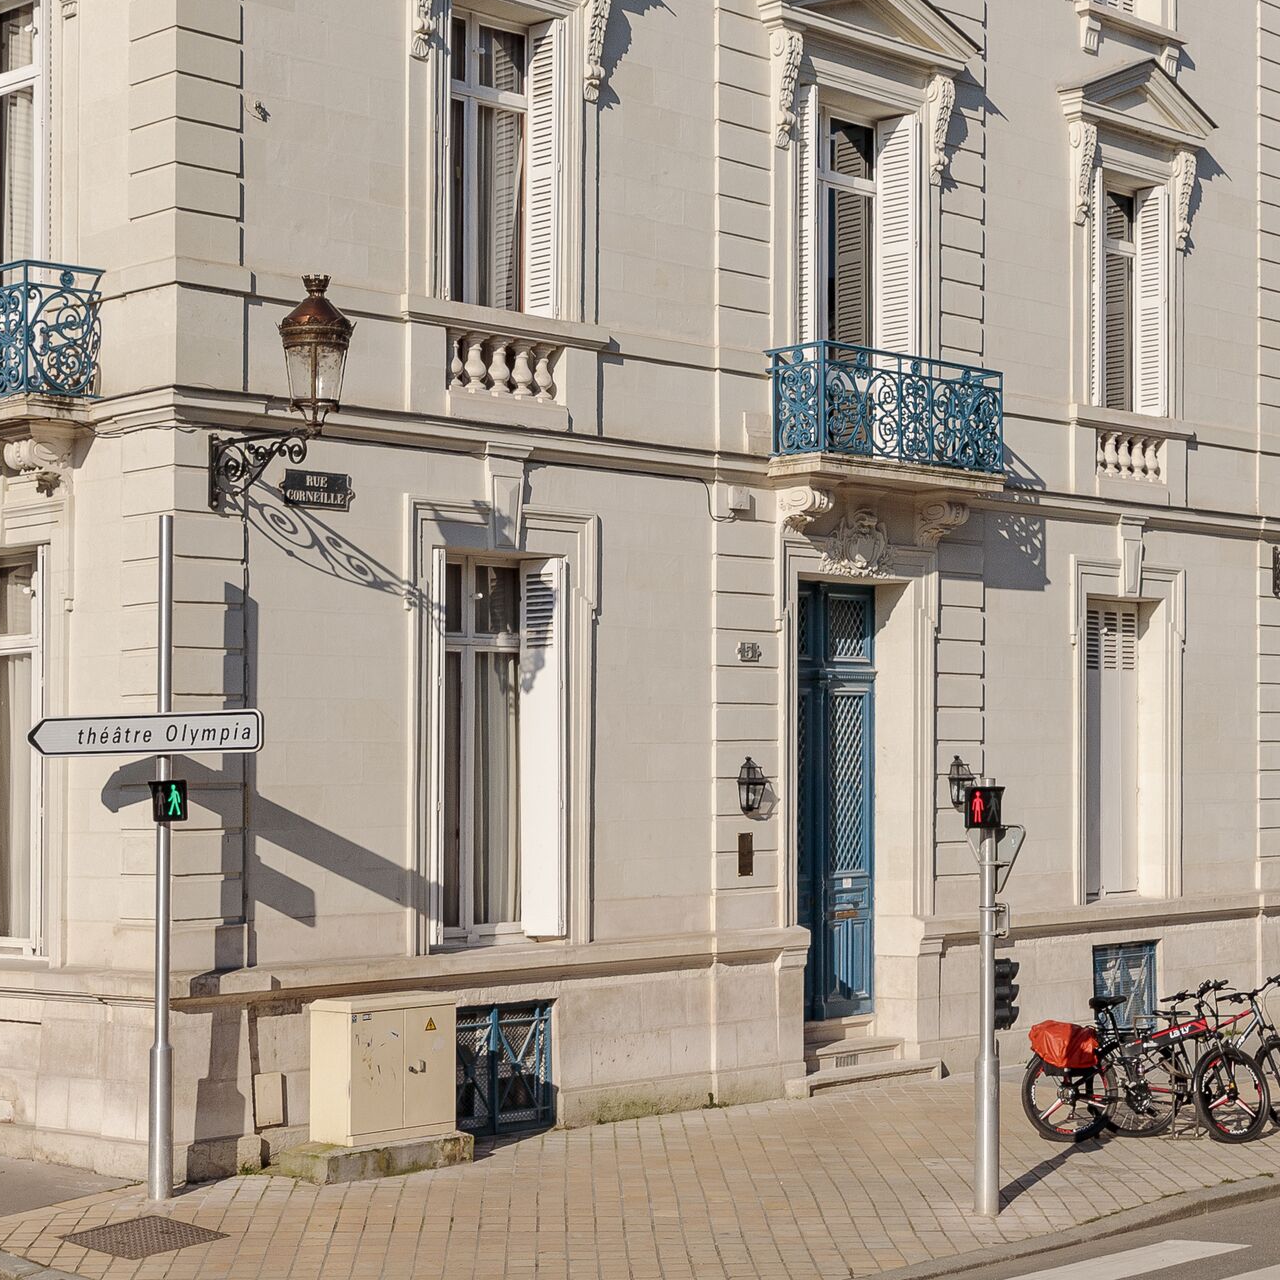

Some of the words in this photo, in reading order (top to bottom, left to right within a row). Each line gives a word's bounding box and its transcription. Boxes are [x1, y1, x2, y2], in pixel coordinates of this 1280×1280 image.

[306, 475, 327, 487] RUE
[286, 489, 344, 504] CORNEILLE
[78, 726, 152, 744] théâtre
[166, 722, 251, 745] Olympia
